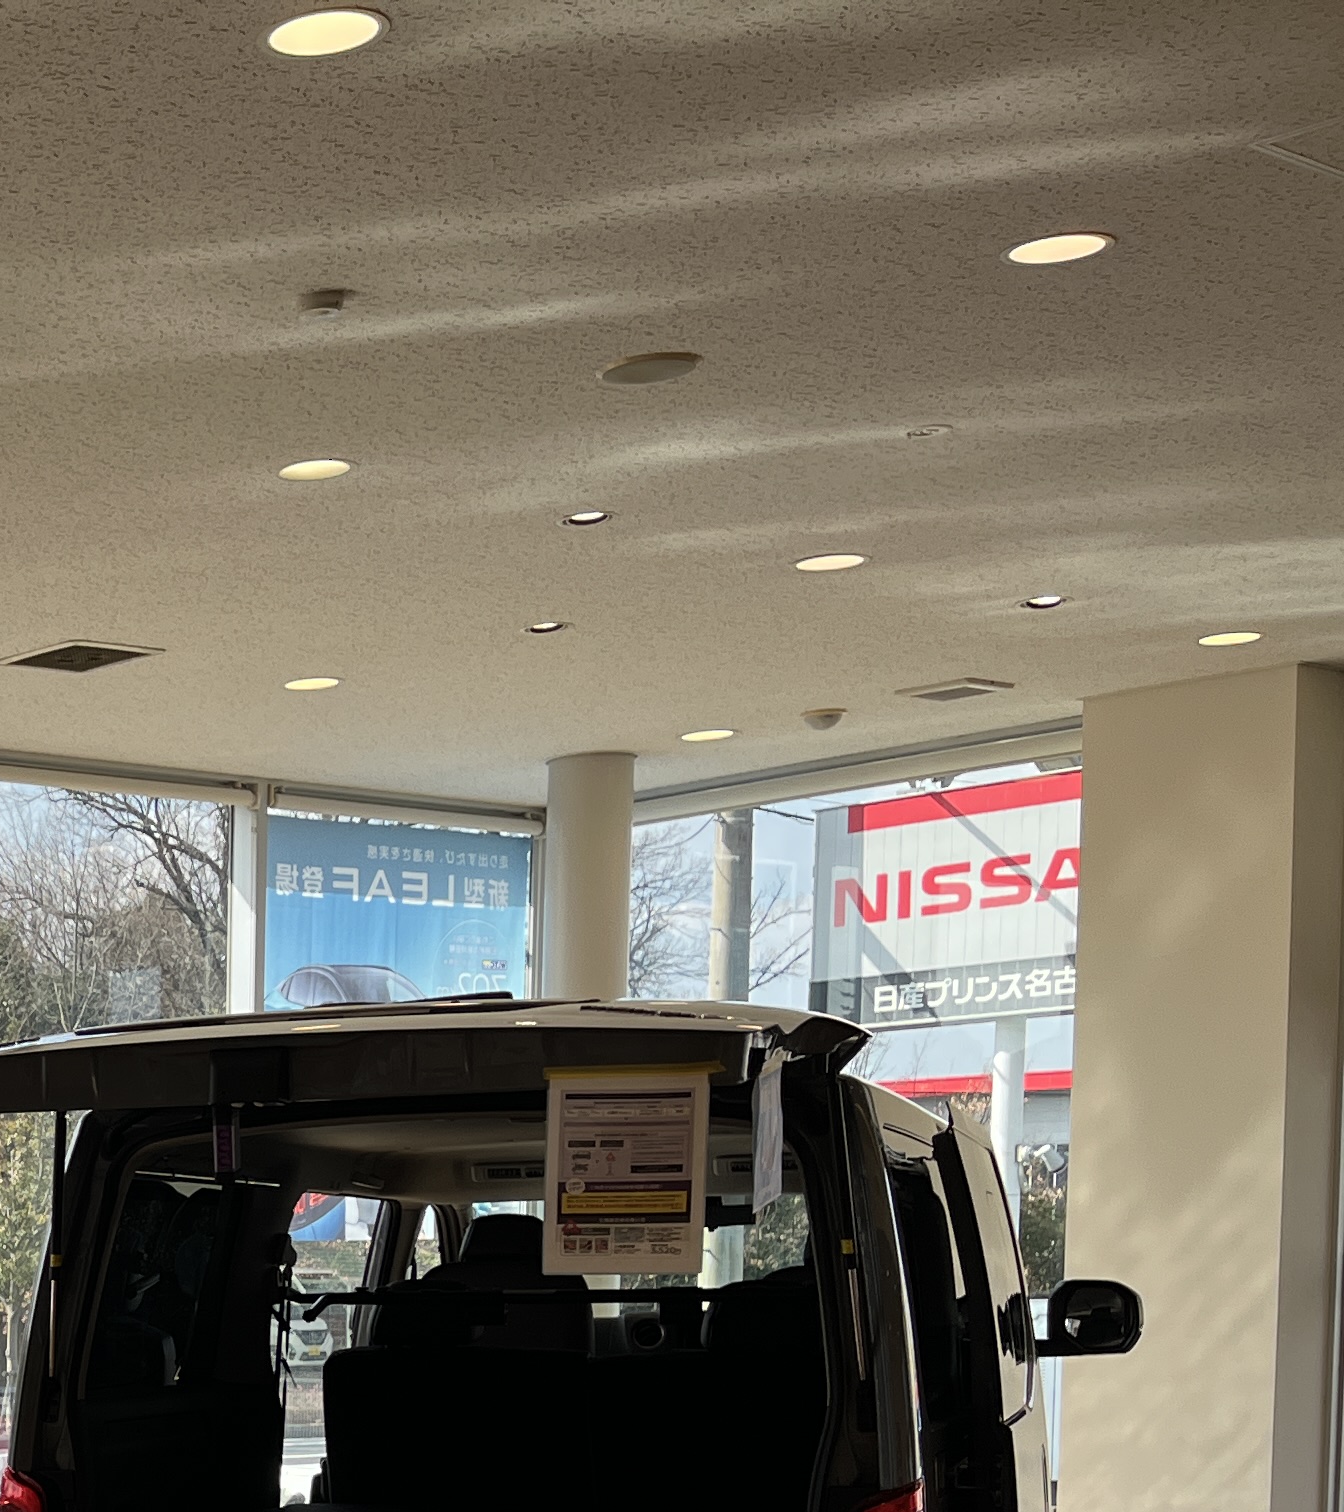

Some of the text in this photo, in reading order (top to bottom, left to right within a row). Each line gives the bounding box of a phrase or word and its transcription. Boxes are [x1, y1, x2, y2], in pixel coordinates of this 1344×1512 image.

[834, 847, 1080, 928] NISSA
[874, 965, 1076, 1014] 日産プリンス名古
